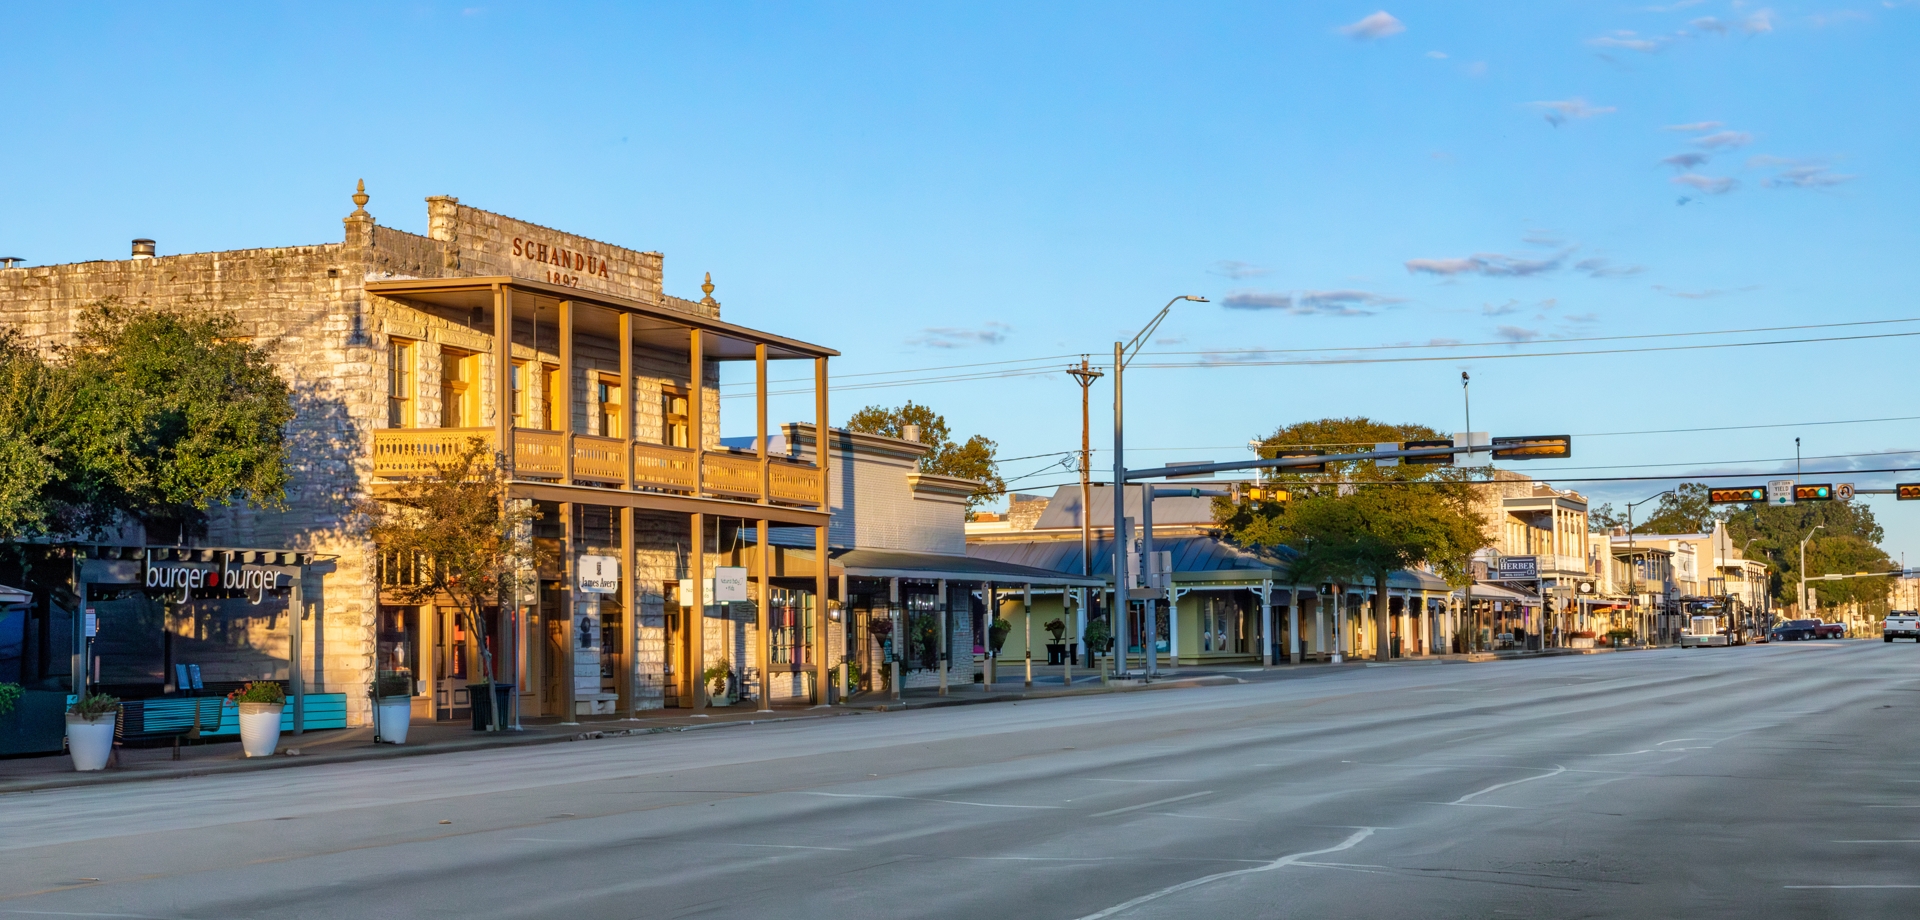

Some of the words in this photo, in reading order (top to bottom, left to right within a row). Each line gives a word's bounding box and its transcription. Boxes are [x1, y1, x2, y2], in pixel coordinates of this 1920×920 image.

[513, 238, 609, 278] SCHANDUA
[546, 270, 579, 288] 1897
[1501, 562, 1535, 570] HERBER
[146, 549, 208, 605] burger
[223, 553, 281, 606] burger
[582, 577, 599, 588] James
[600, 578, 616, 590] Avery
